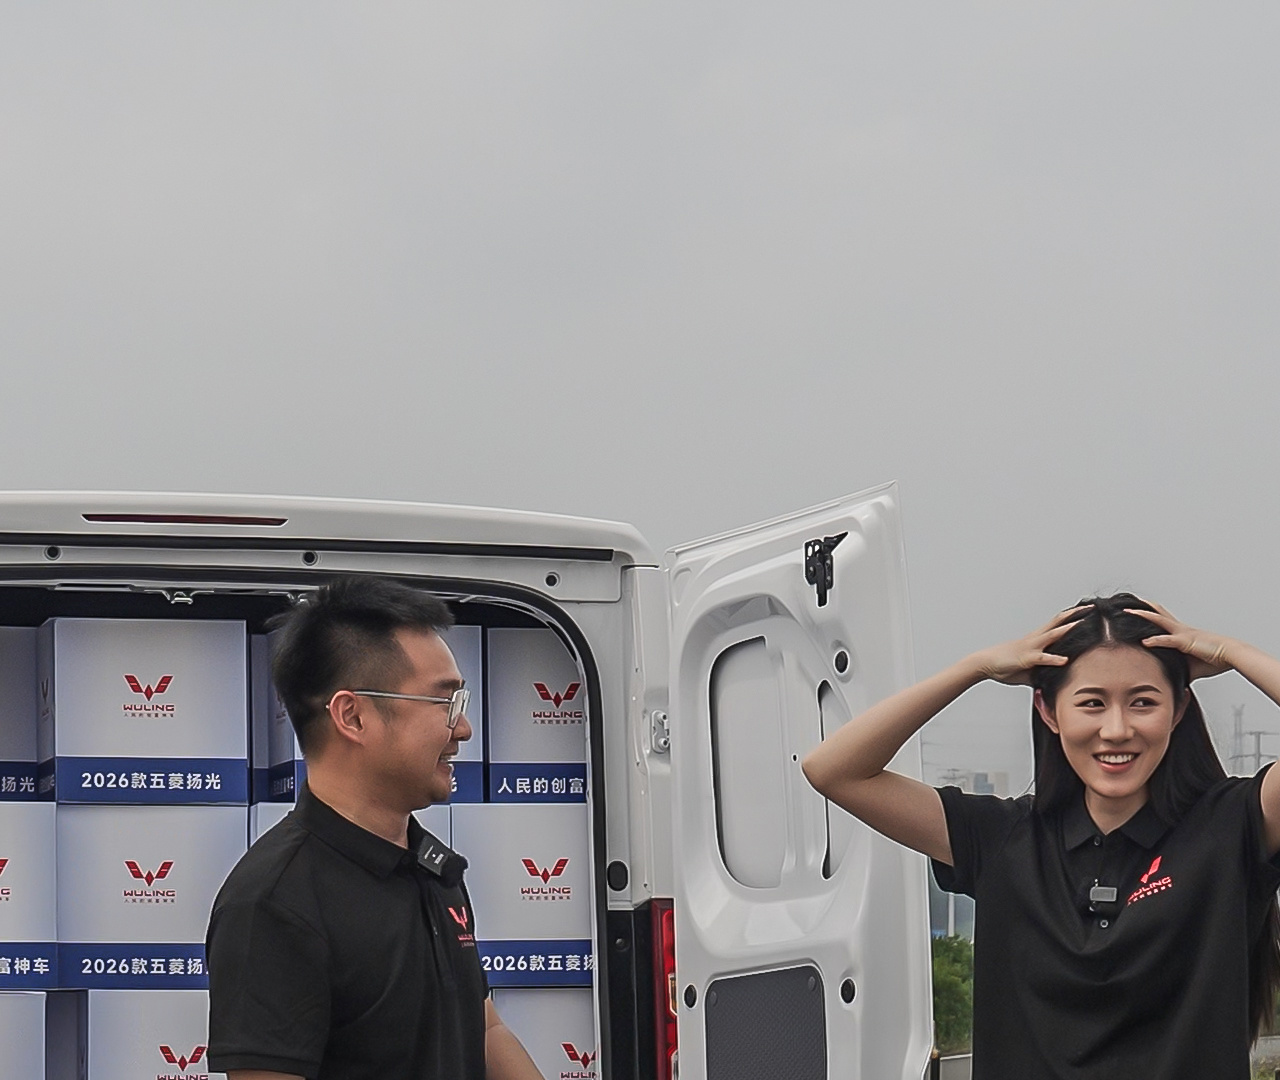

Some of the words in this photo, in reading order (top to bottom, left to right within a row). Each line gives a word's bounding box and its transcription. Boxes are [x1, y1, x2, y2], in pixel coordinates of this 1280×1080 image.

[122, 703, 175, 712] WULING
[81, 772, 221, 790] 2026款五菱扬光
[497, 777, 584, 794] 人民的创富
[123, 889, 176, 897] WULING
[520, 886, 571, 895] WULING
[81, 957, 209, 975] 2026款五菱扬
